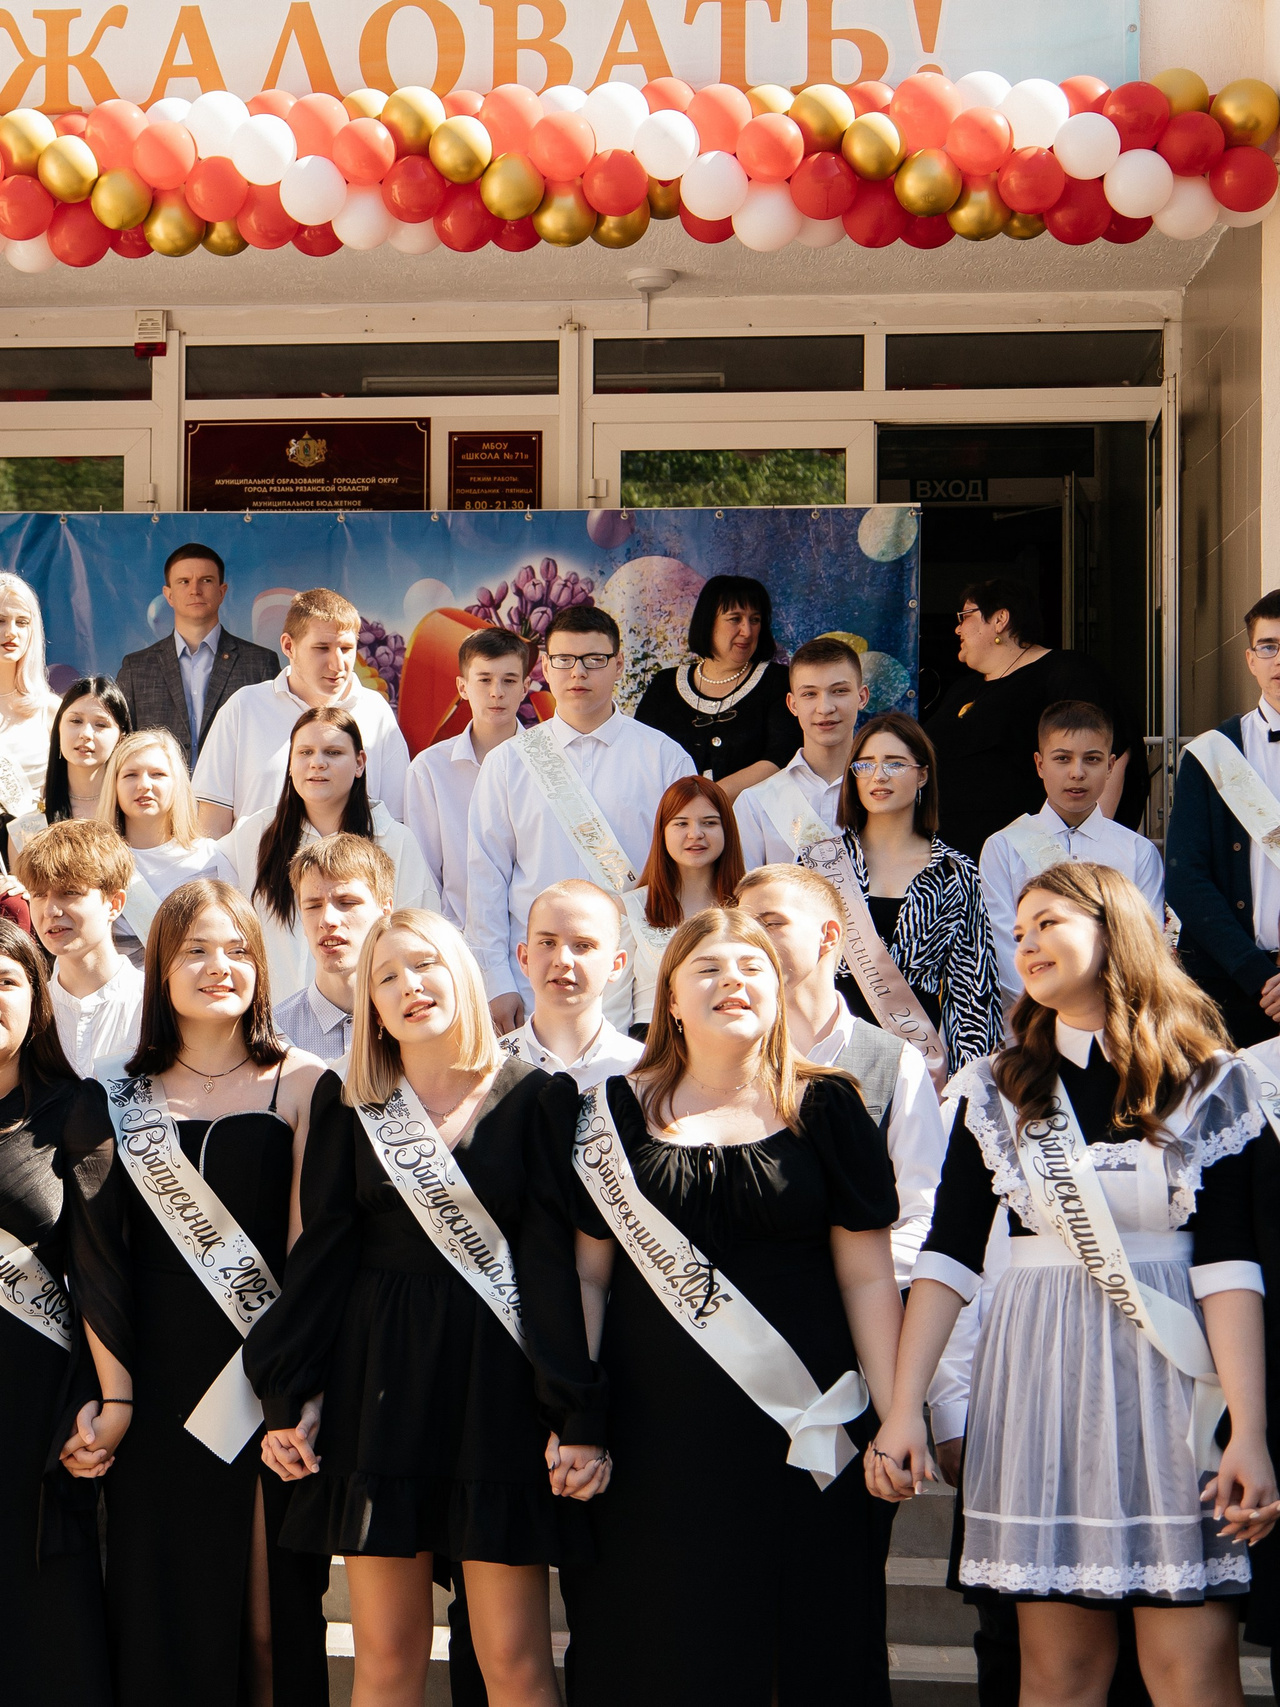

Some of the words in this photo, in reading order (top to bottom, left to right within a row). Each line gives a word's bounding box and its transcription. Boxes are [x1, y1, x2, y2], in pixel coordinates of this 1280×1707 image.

[461, 452, 500, 460] «ШКОЛА
[482, 442, 508, 450] МБОУ
[215, 478, 275, 486] МУНИЦИПАЛЬНОЕ
[333, 477, 376, 485] ГОРОДСКОЙ
[916, 479, 983, 501] ВХОД
[889, 1007, 938, 1057] 2025
[119, 1108, 226, 1268] Выпускник
[219, 1256, 276, 1312] 2025
[376, 1120, 504, 1283] Выпускница
[574, 1116, 675, 1276] Выпускница
[665, 1262, 733, 1318] 2025
